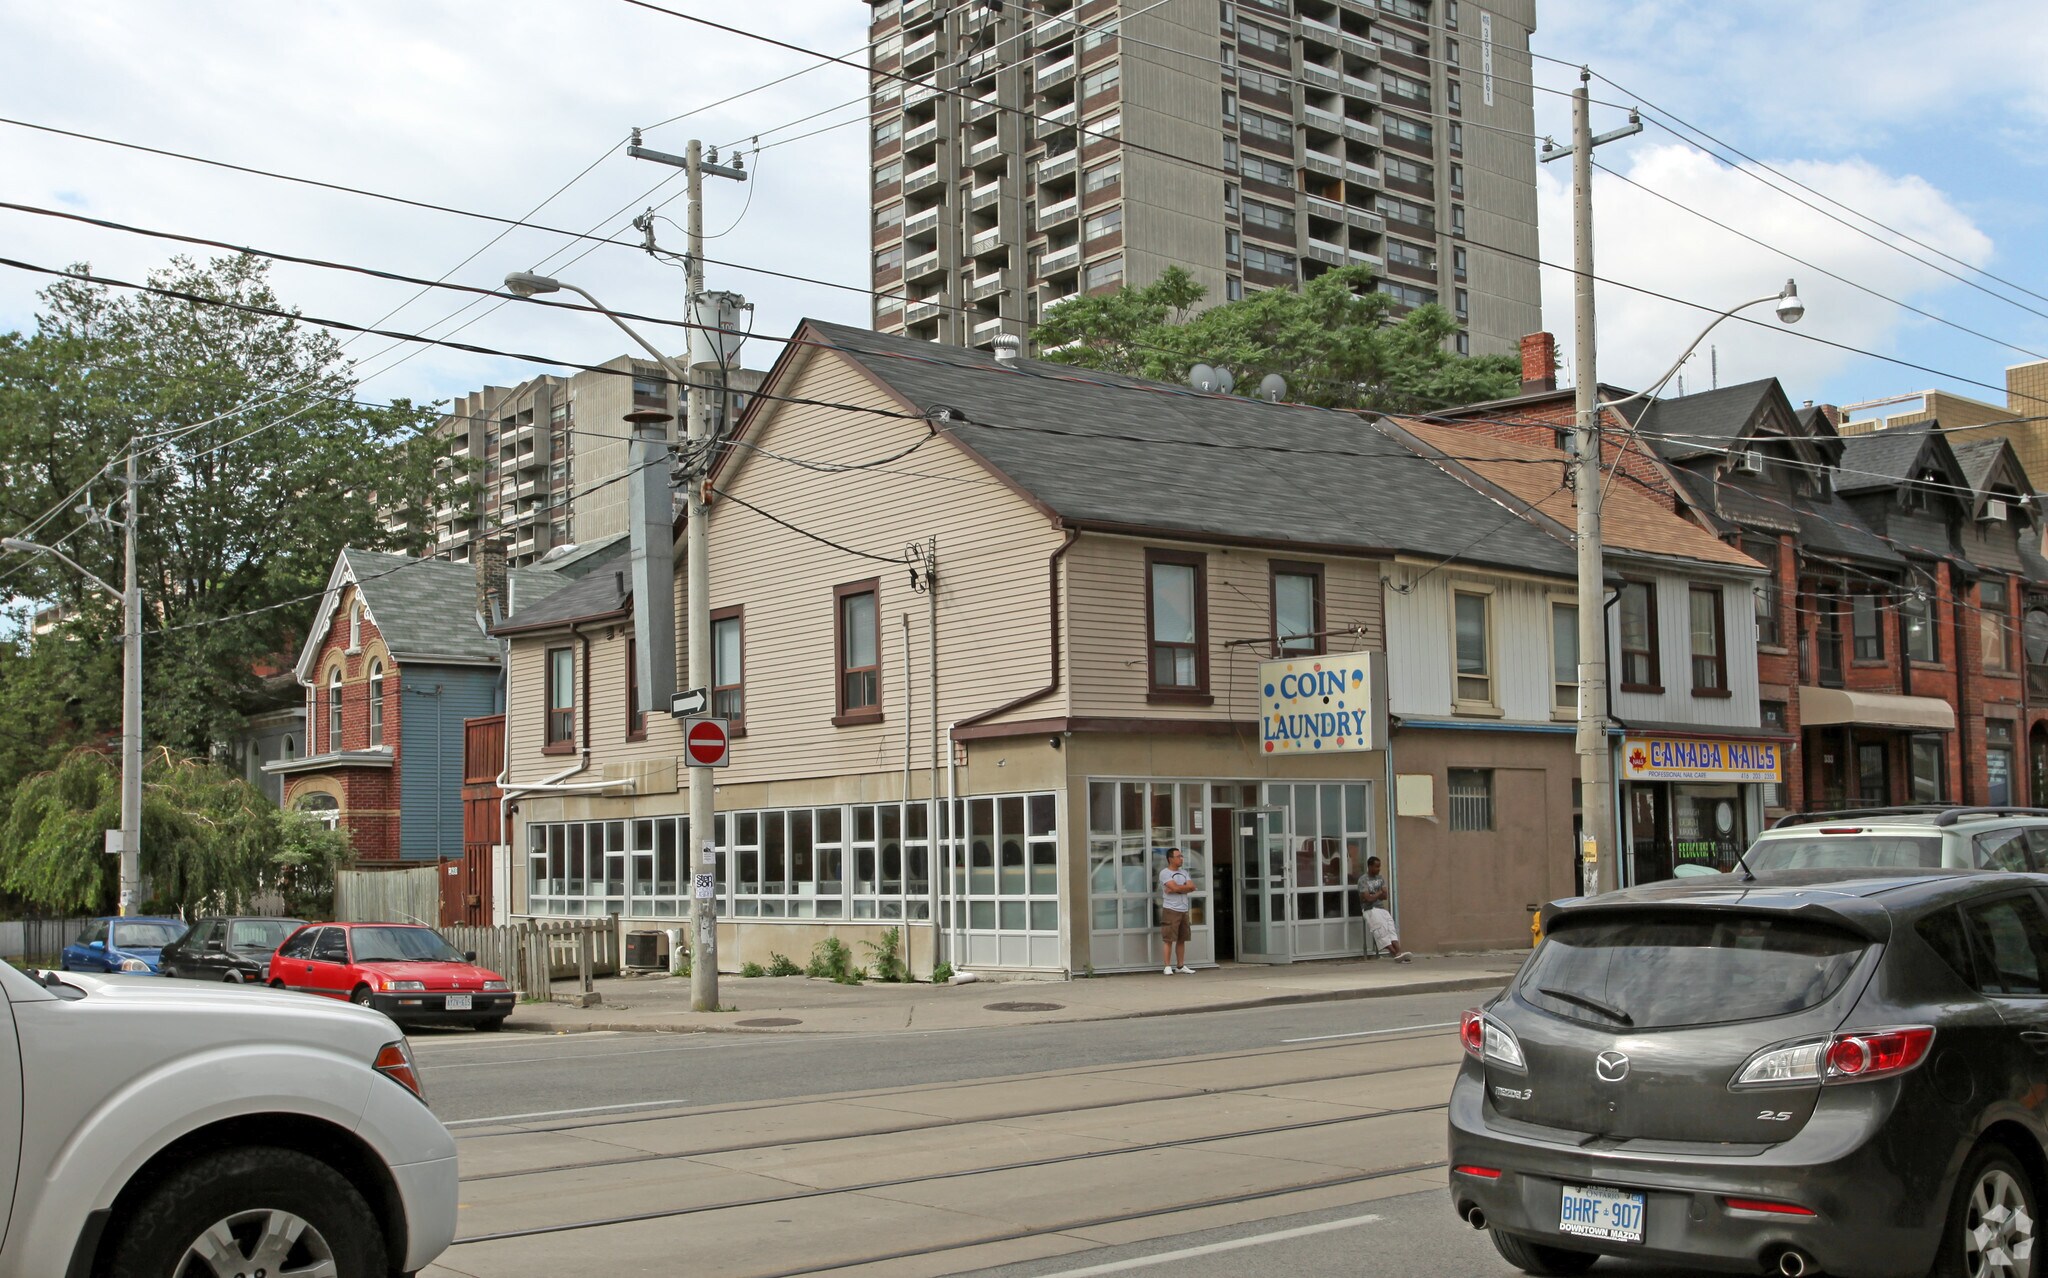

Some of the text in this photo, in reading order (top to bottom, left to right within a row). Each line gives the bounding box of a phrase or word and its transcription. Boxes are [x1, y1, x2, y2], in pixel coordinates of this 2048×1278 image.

[1280, 669, 1347, 699] COIN
[1263, 710, 1366, 741] LAUNDRY
[1632, 758, 1644, 766] NAILS
[1650, 741, 1775, 770] CANADA NAILS
[1648, 770, 1707, 780] PROFESSIONAL NAIL CARE
[1756, 1110, 1793, 1121] 2.5
[1562, 1196, 1602, 1224] BHRF
[1611, 1201, 1642, 1230] 907
[1559, 1222, 1608, 1237] DOWNTOWN
[1610, 1229, 1641, 1242] MAZDA
